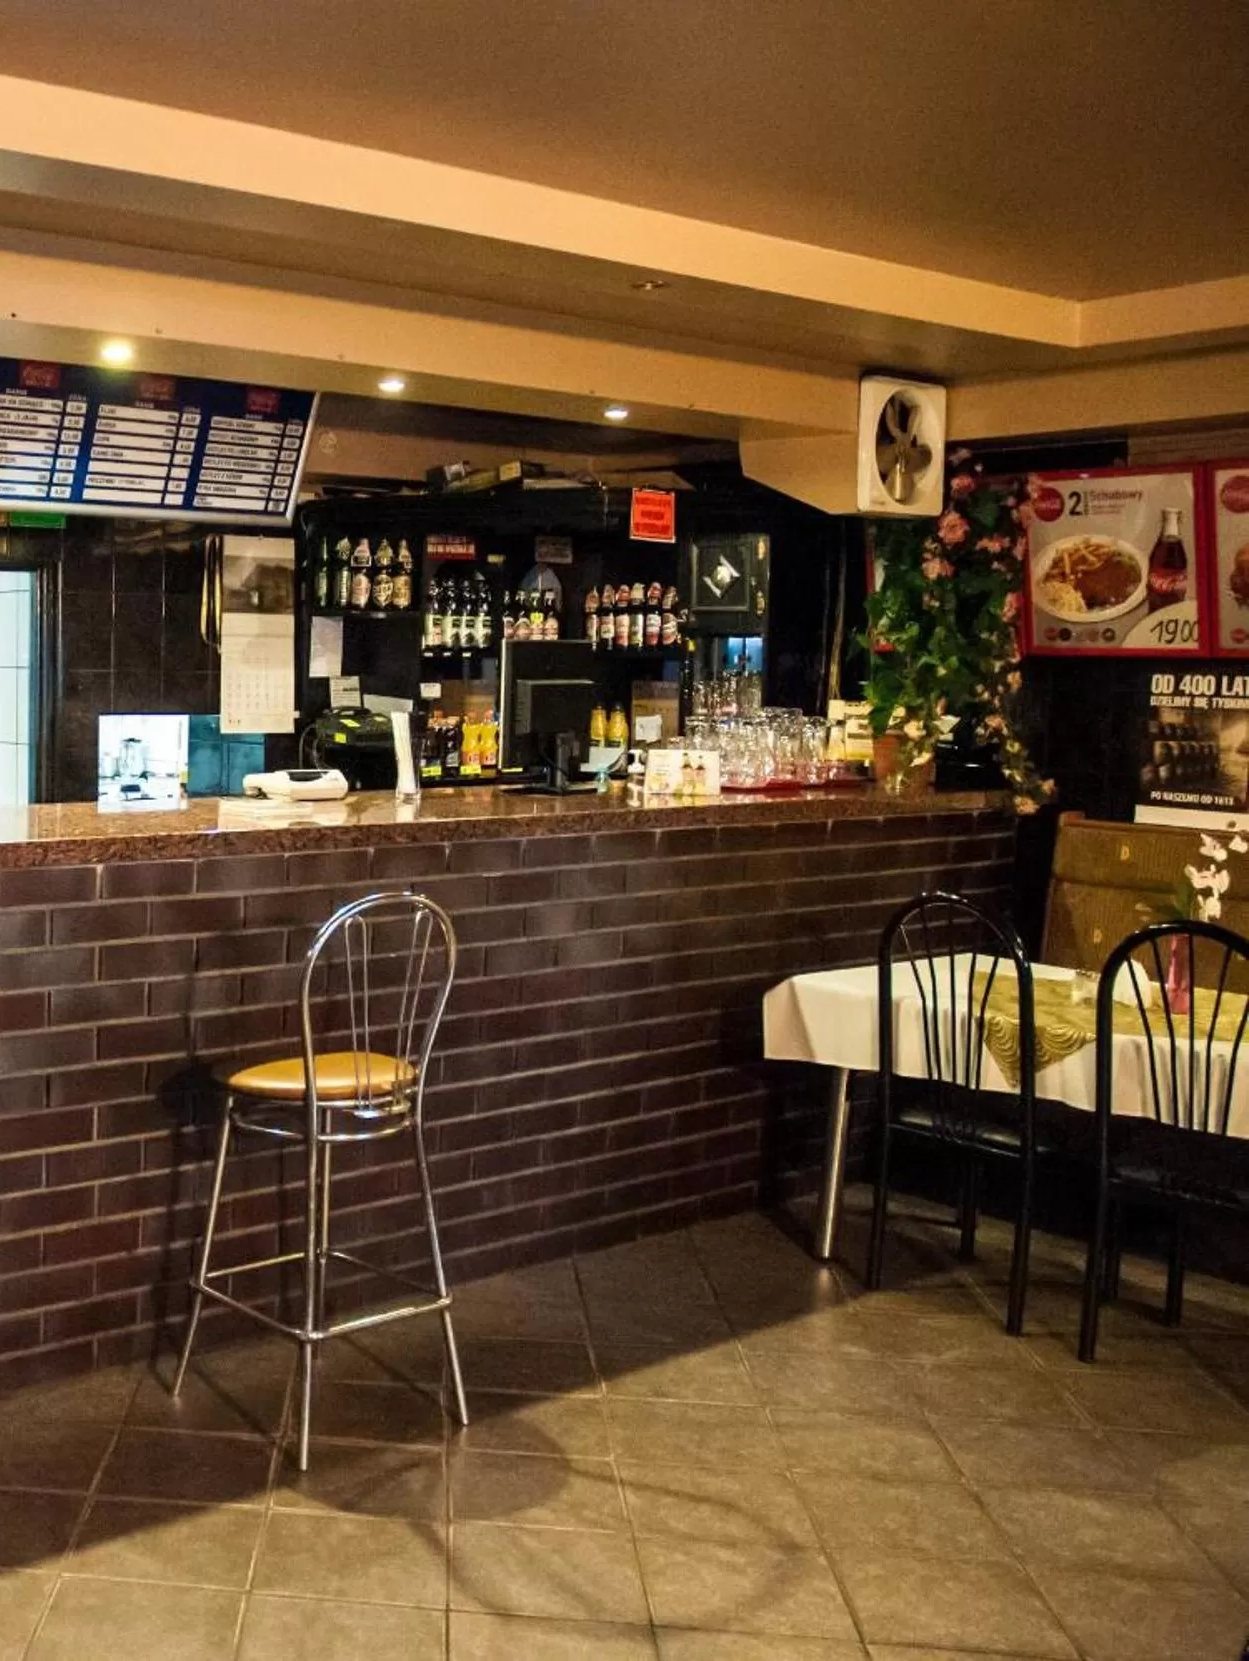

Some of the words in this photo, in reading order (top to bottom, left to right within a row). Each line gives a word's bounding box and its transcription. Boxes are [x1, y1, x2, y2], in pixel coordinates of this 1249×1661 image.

[1068, 490, 1083, 517] 2
[1151, 674, 1175, 694] OD
[1179, 674, 1216, 696] 400
